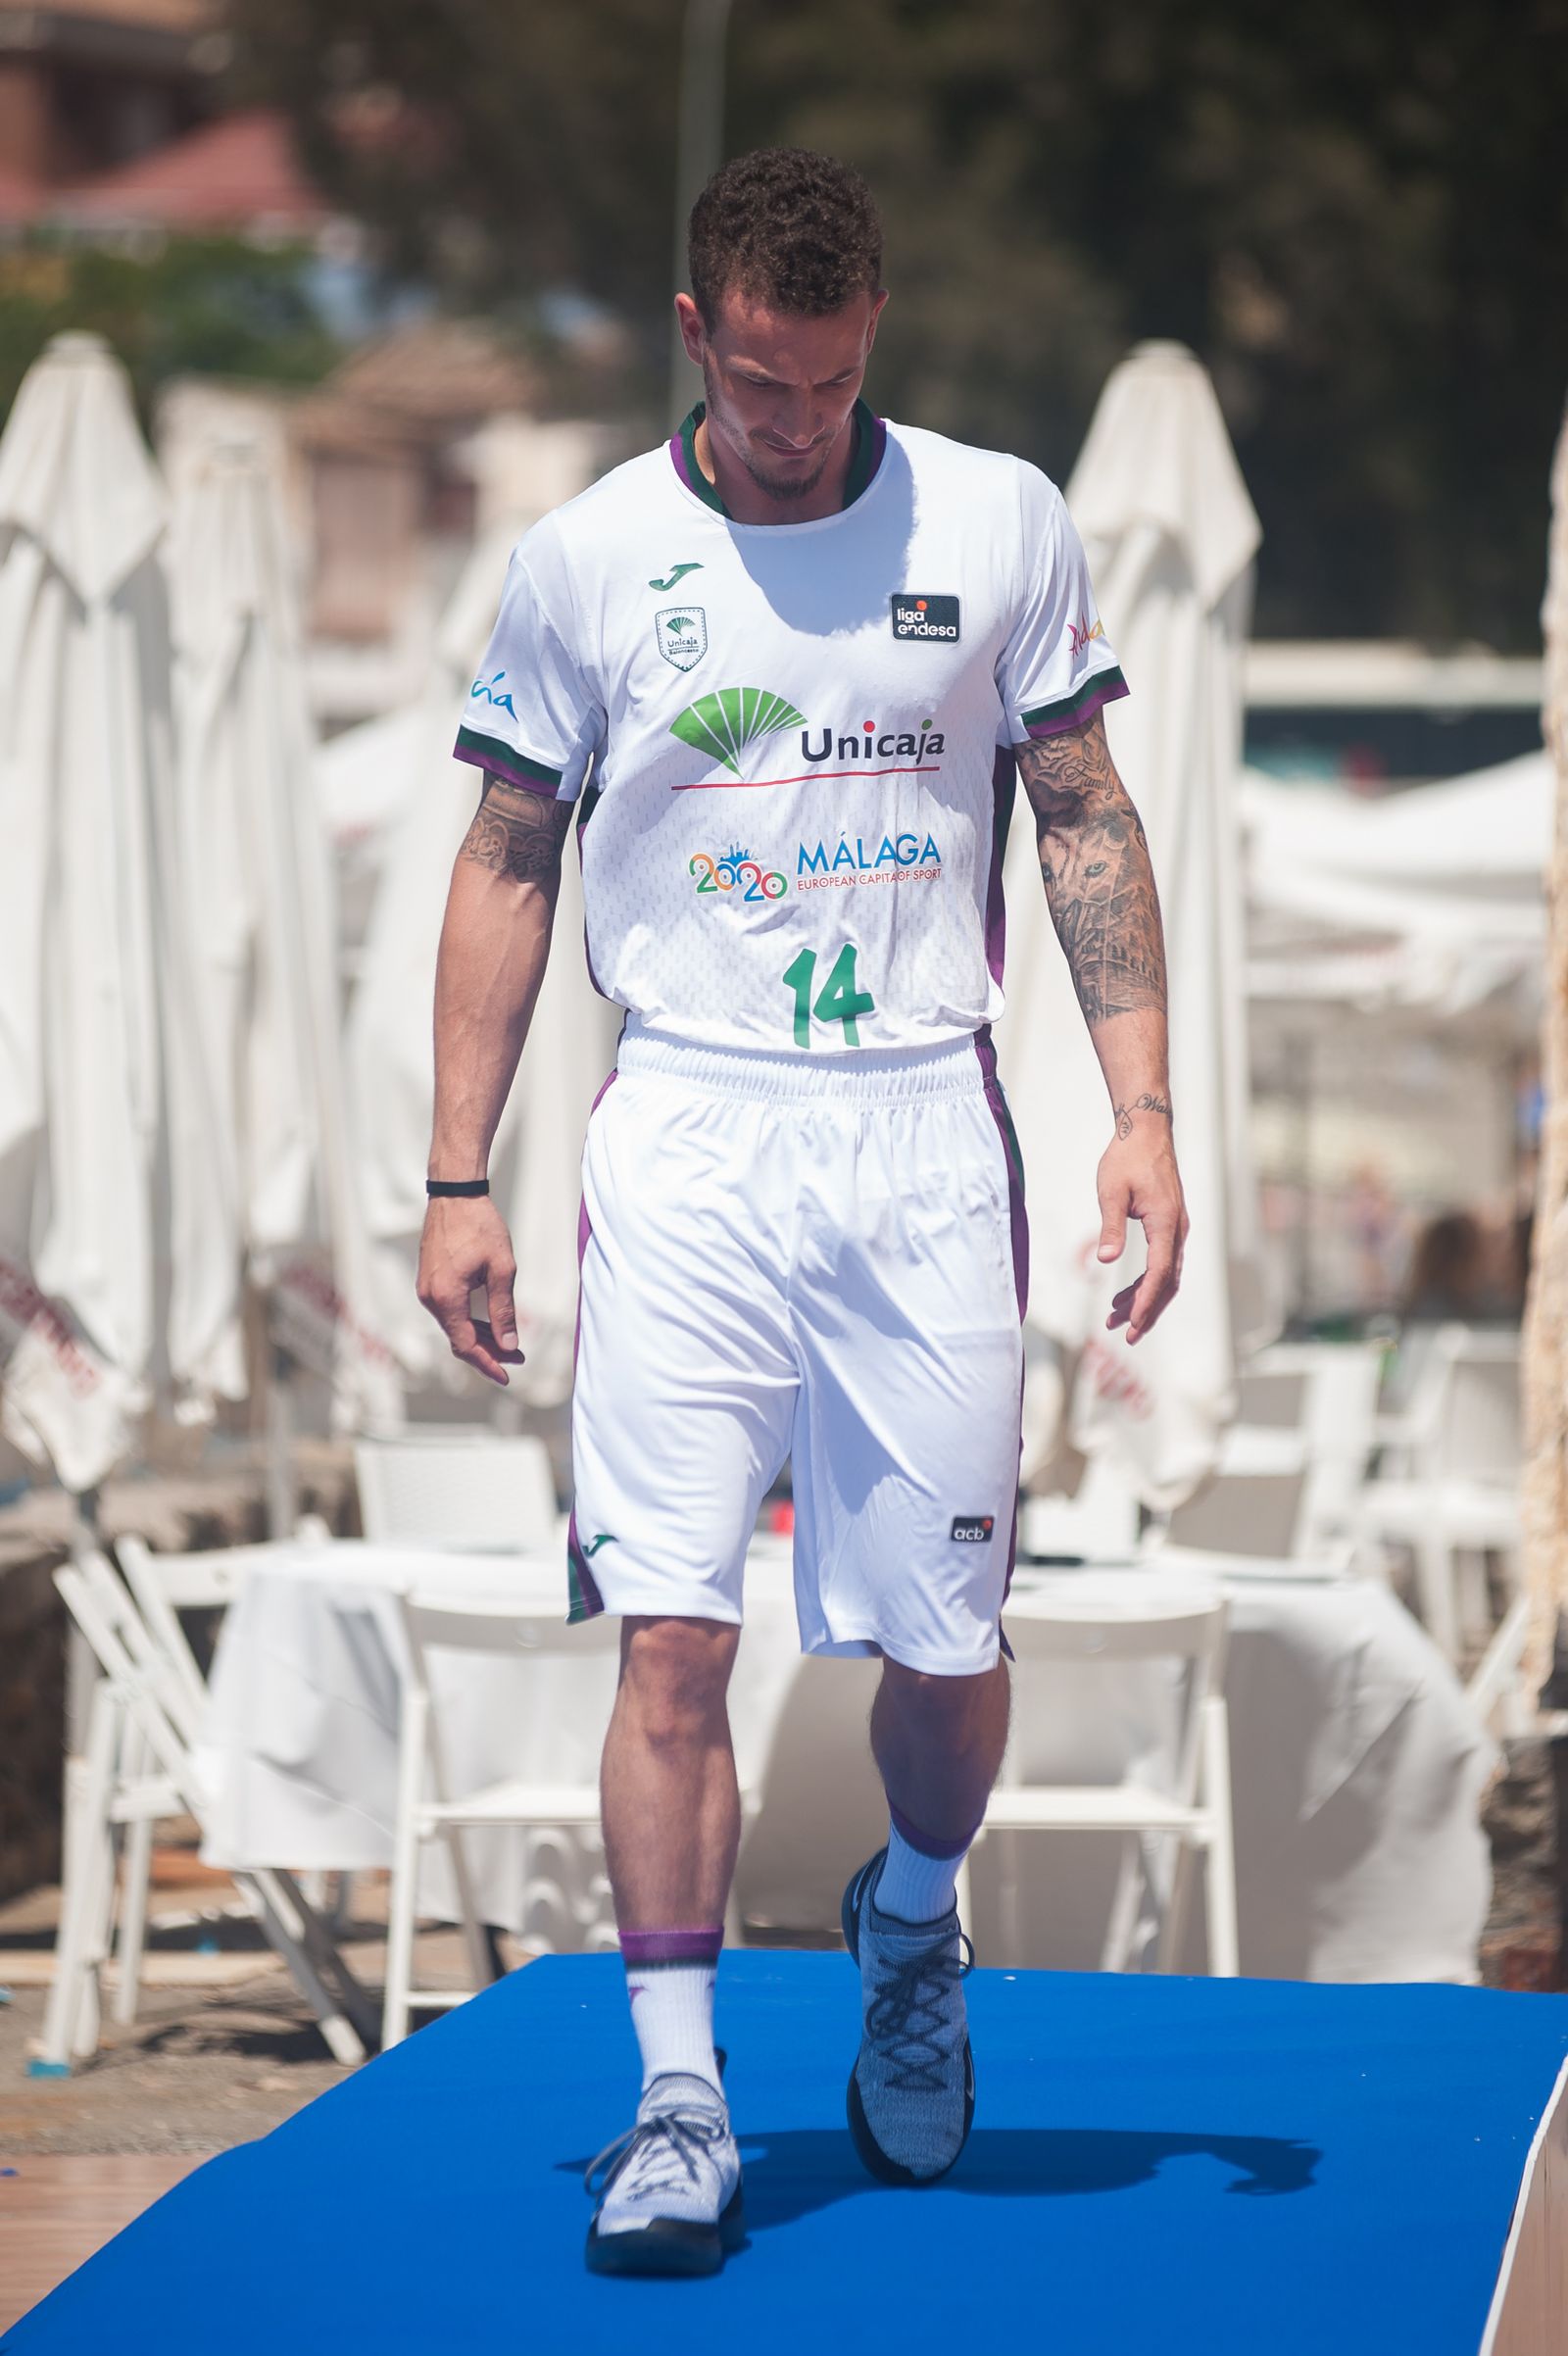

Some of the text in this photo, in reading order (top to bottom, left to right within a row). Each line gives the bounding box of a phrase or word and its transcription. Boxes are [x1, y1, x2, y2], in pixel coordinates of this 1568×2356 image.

[897, 608, 924, 623] liga
[898, 622, 956, 637] endesa
[667, 636, 698, 648] Unicaja
[802, 718, 945, 765] Unicaja
[1064, 764, 1117, 801] Family
[797, 831, 941, 875] MÁLAGA
[689, 854, 788, 902] 2020
[798, 875, 856, 891] EUROPEAN
[859, 871, 899, 885] CAPITA
[913, 868, 942, 880] SPORT
[782, 943, 875, 1049] 14
[954, 1527, 984, 1541] acb
